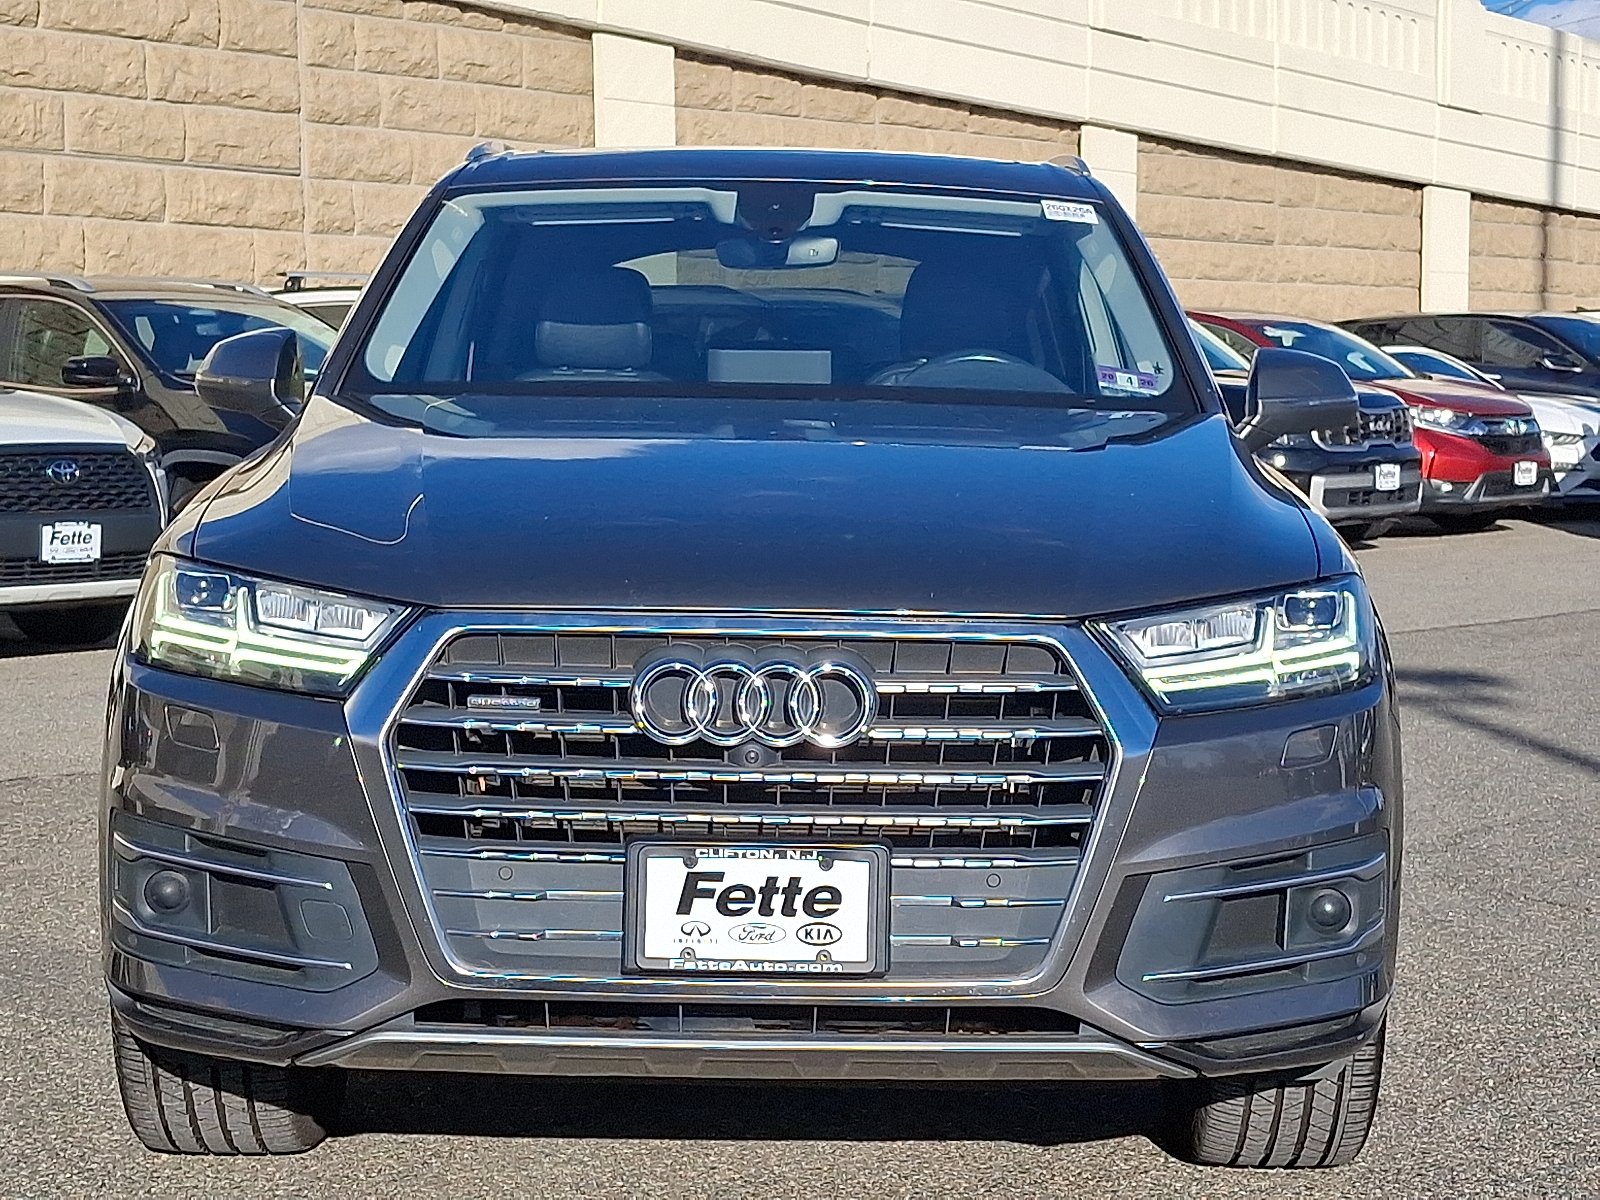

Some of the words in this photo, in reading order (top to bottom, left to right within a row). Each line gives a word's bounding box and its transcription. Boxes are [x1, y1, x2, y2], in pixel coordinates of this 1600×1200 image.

[49, 530, 93, 545] Fette
[676, 871, 843, 918] Fette
[738, 926, 776, 941] Ford
[804, 928, 834, 940] KIA
[669, 958, 844, 972] FetteAuto.com
